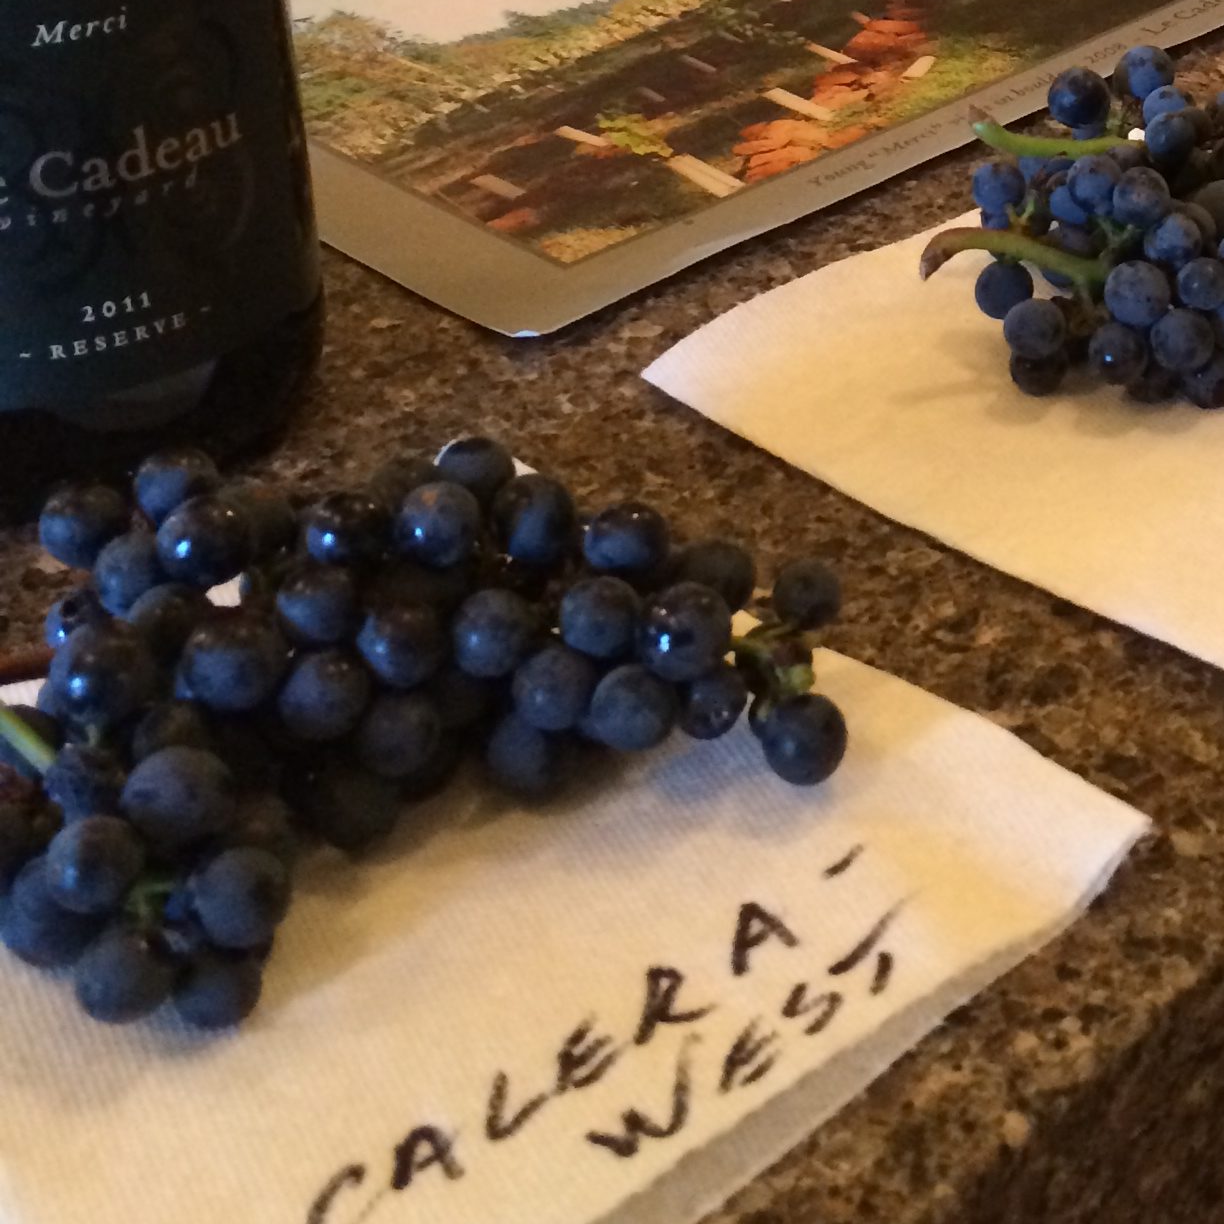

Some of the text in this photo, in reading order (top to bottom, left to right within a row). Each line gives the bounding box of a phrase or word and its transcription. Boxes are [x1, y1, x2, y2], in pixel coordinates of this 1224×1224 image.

[30, 6, 129, 47] Merci
[28, 111, 243, 199] Cadeau
[82, 290, 152, 322] 2011
[49, 312, 188, 361] RESERVE
[587, 892, 914, 1158] WEST
